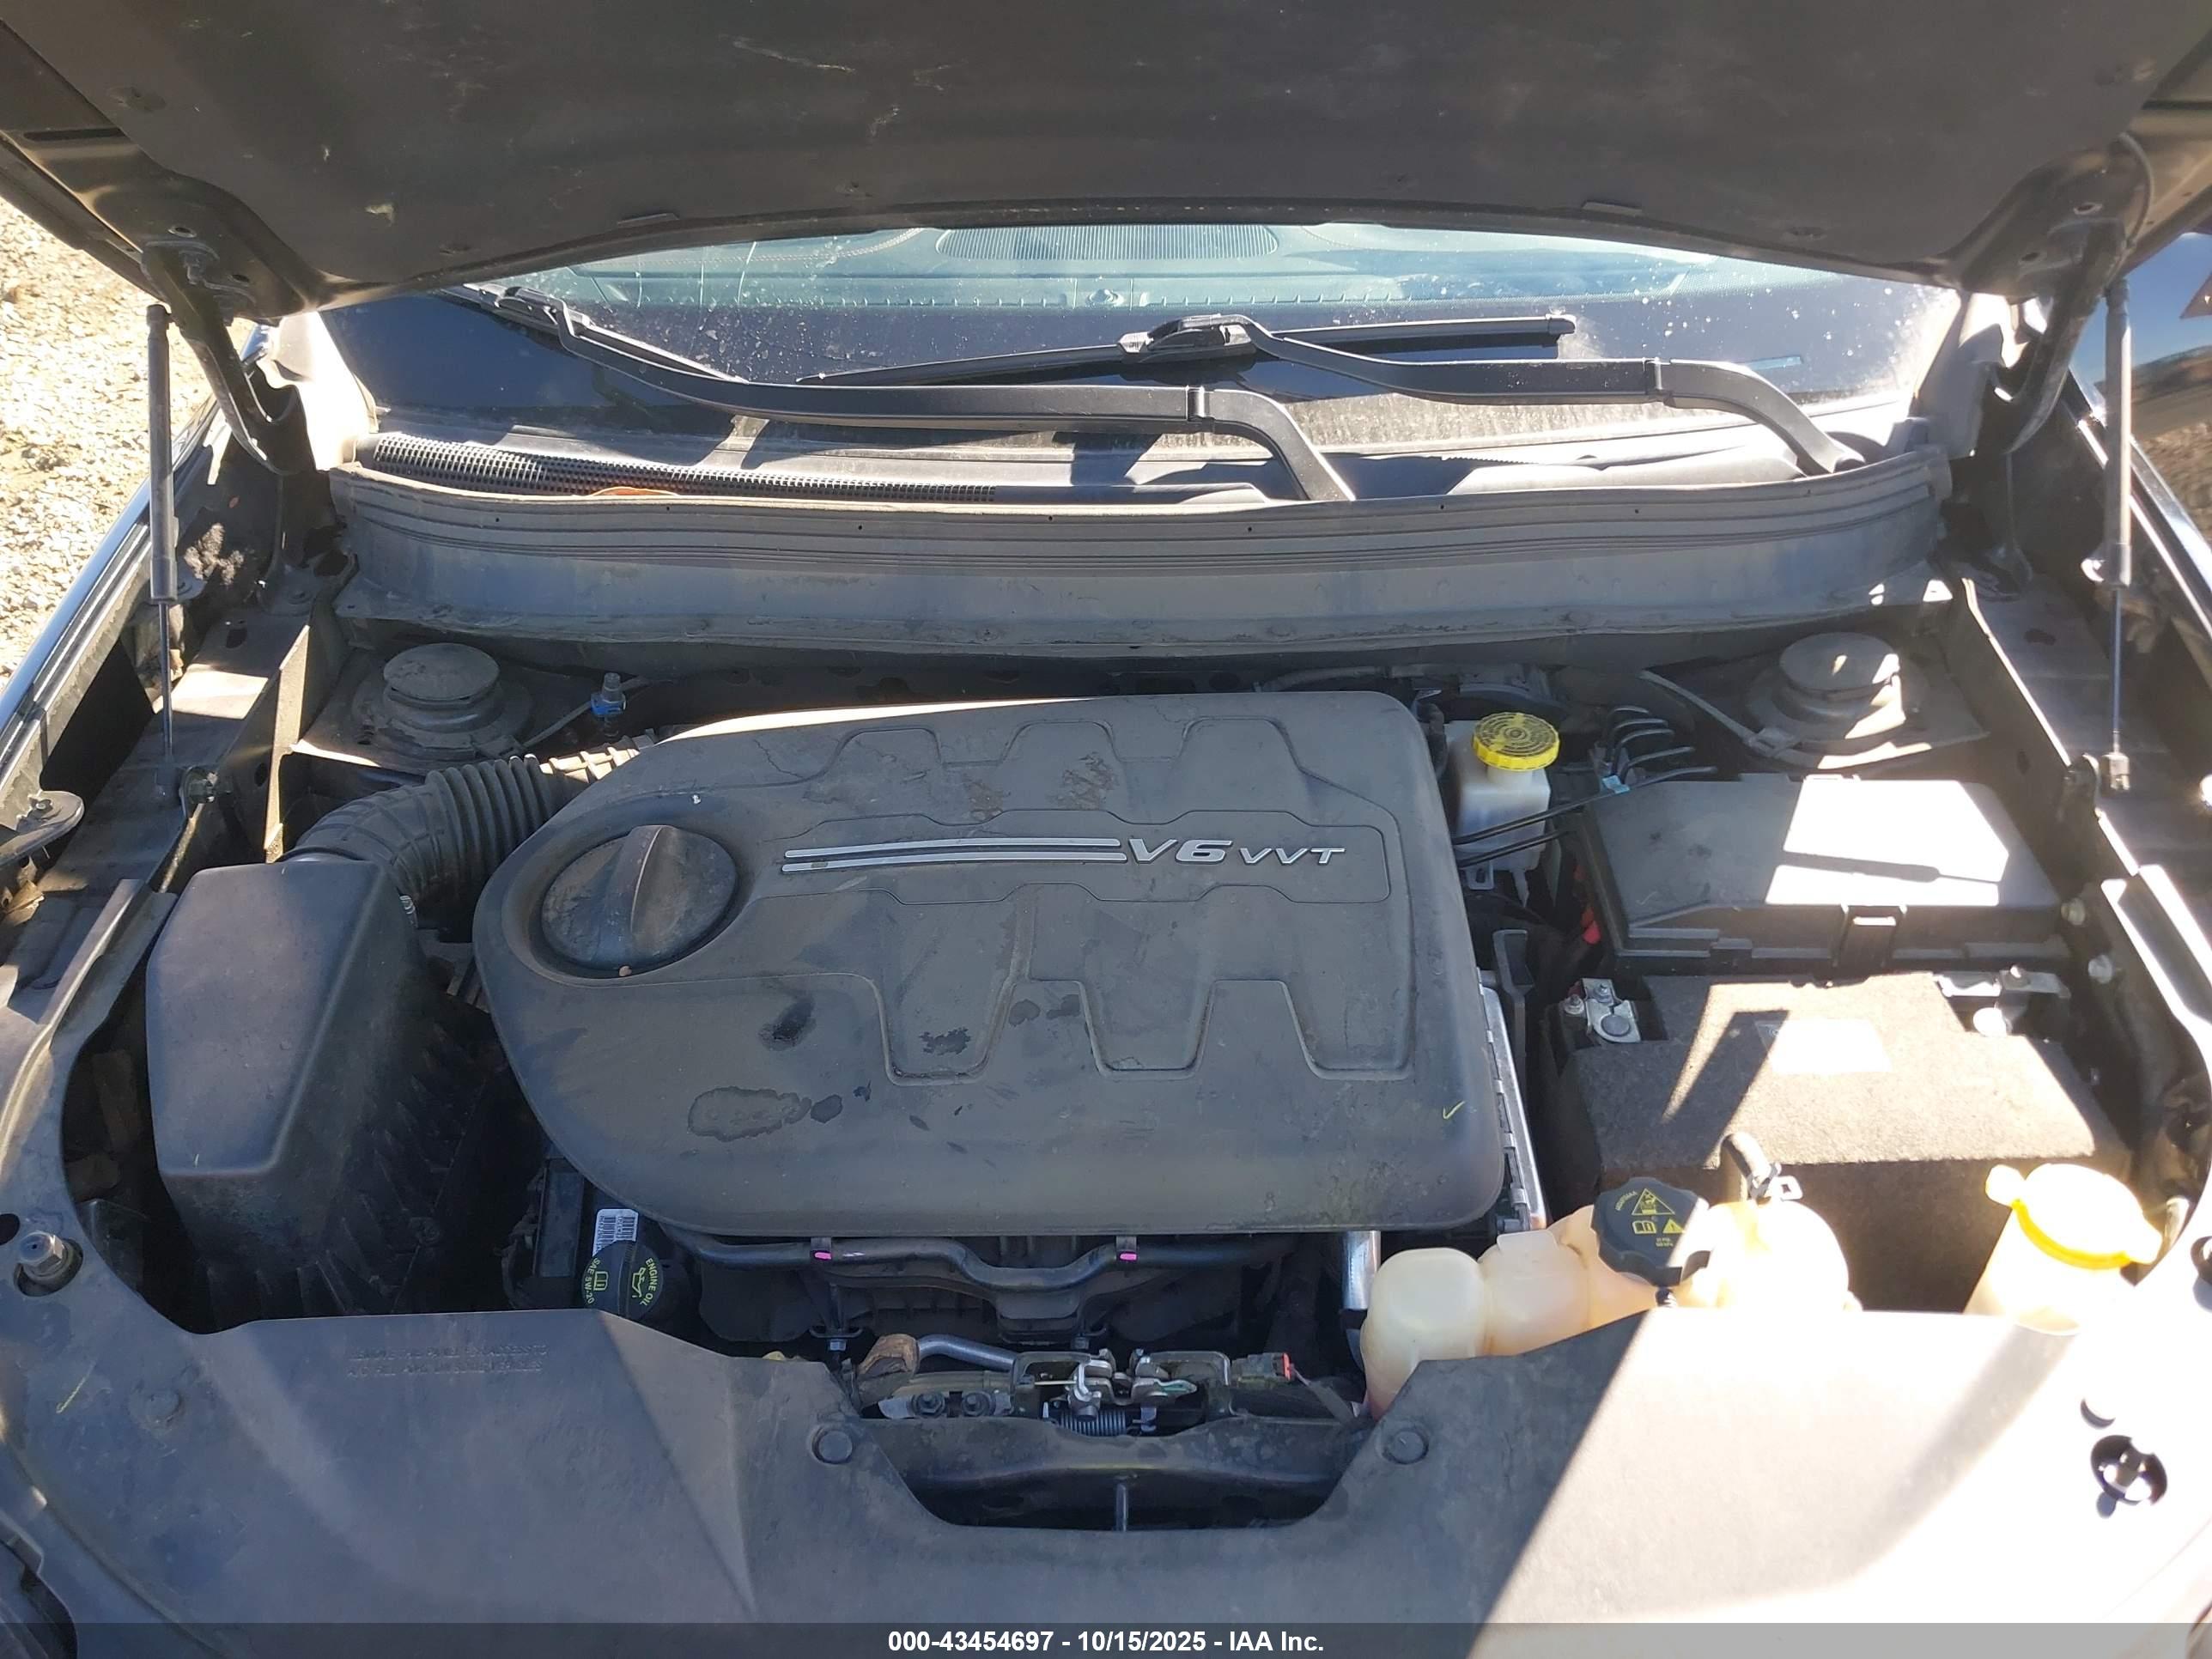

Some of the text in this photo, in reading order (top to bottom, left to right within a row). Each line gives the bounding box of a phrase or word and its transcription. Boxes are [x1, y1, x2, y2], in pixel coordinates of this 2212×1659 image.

[1129, 838, 1345, 865] V6 VVT
[583, 1257, 601, 1304] SAE 5W-20
[639, 1257, 659, 1306] ENGINE OIL
